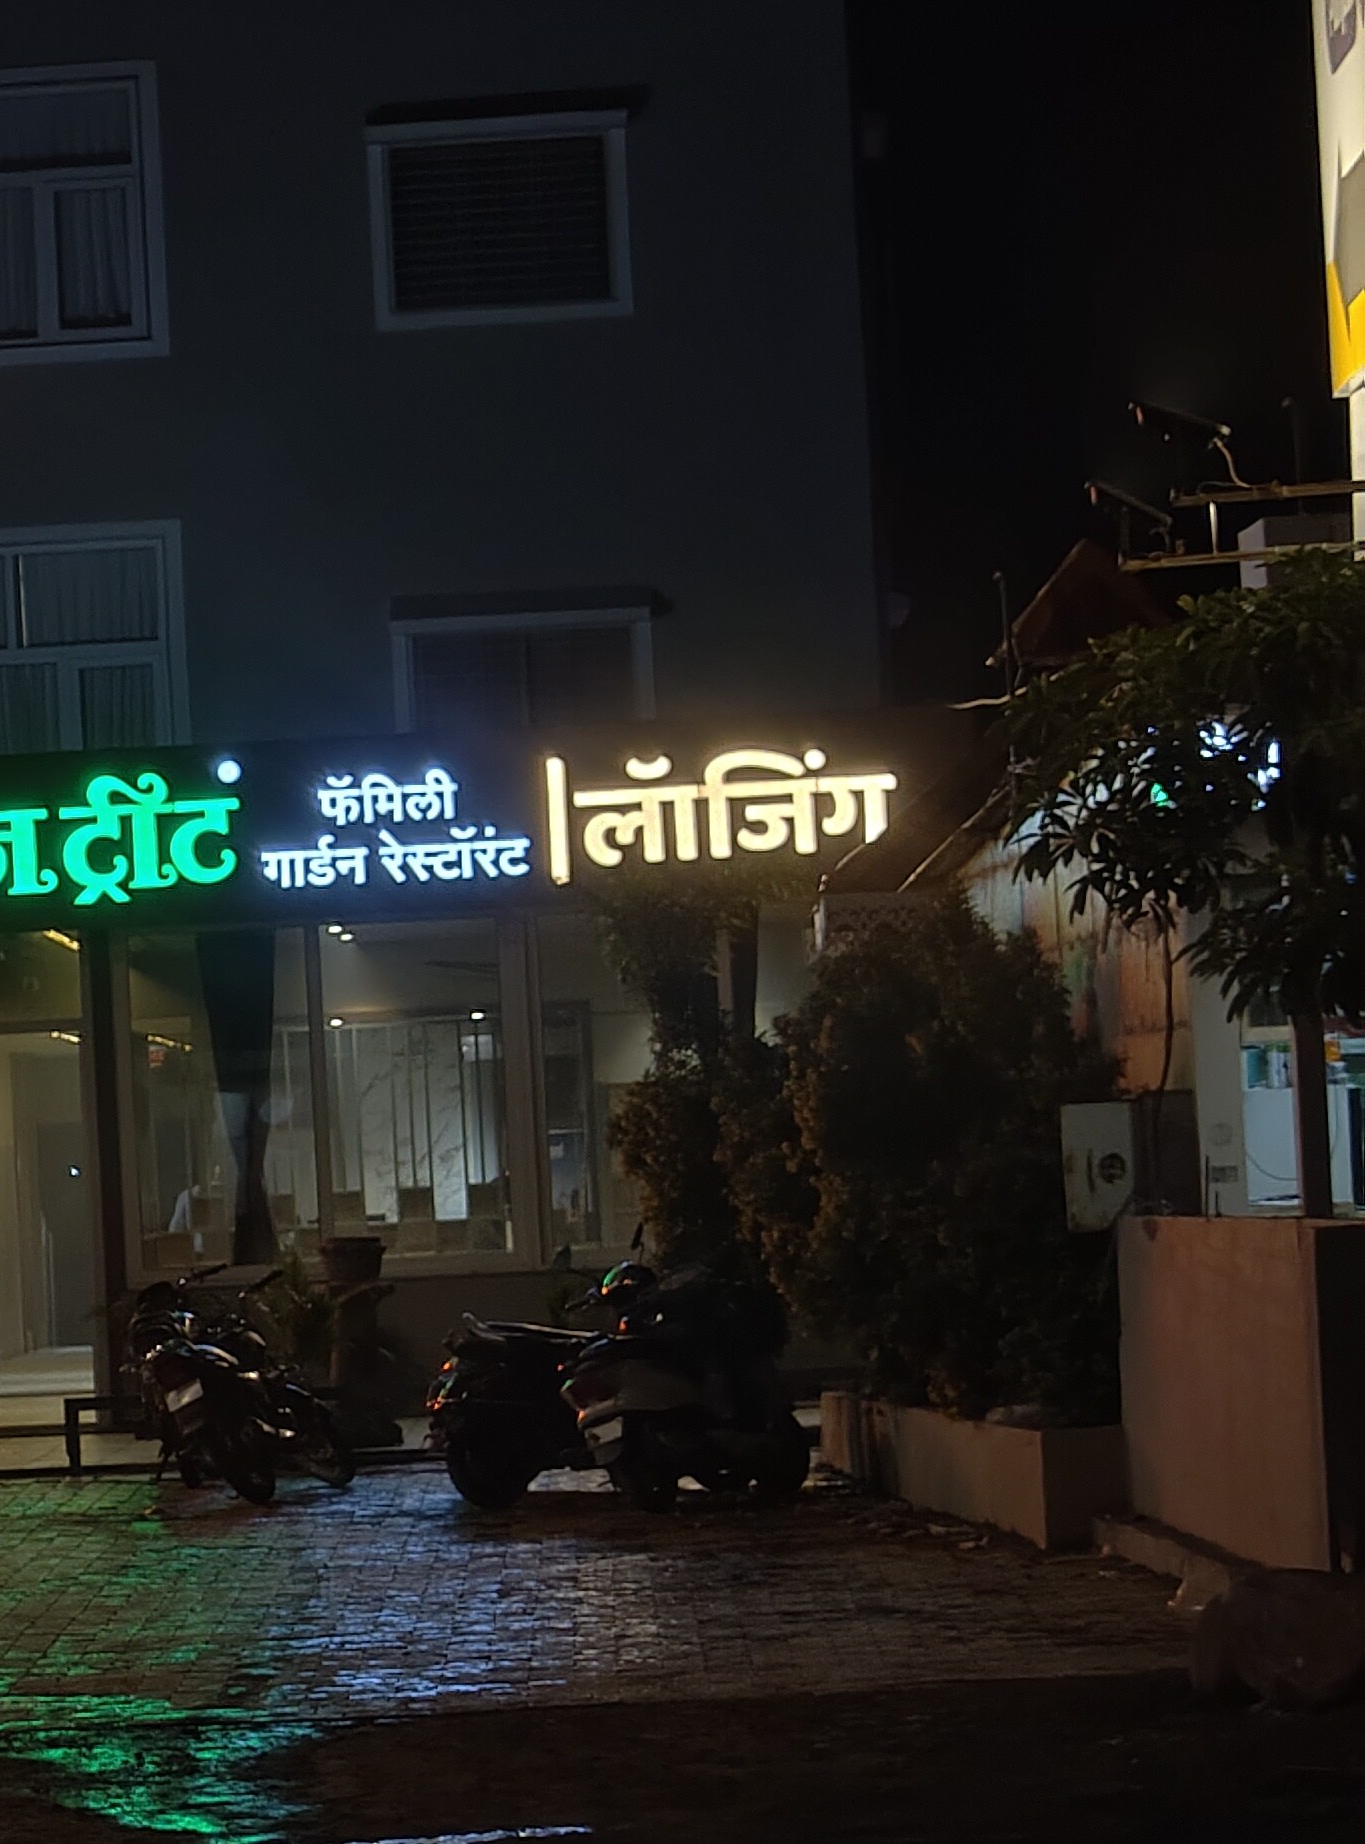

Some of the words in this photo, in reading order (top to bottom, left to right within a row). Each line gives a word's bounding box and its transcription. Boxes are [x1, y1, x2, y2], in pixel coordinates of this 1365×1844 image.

[316, 767, 459, 826] फॅमिली
[572, 748, 897, 867] लॉजिंग
[261, 832, 370, 889] गार्डन
[377, 826, 531, 884] रेस्टॉरंट
